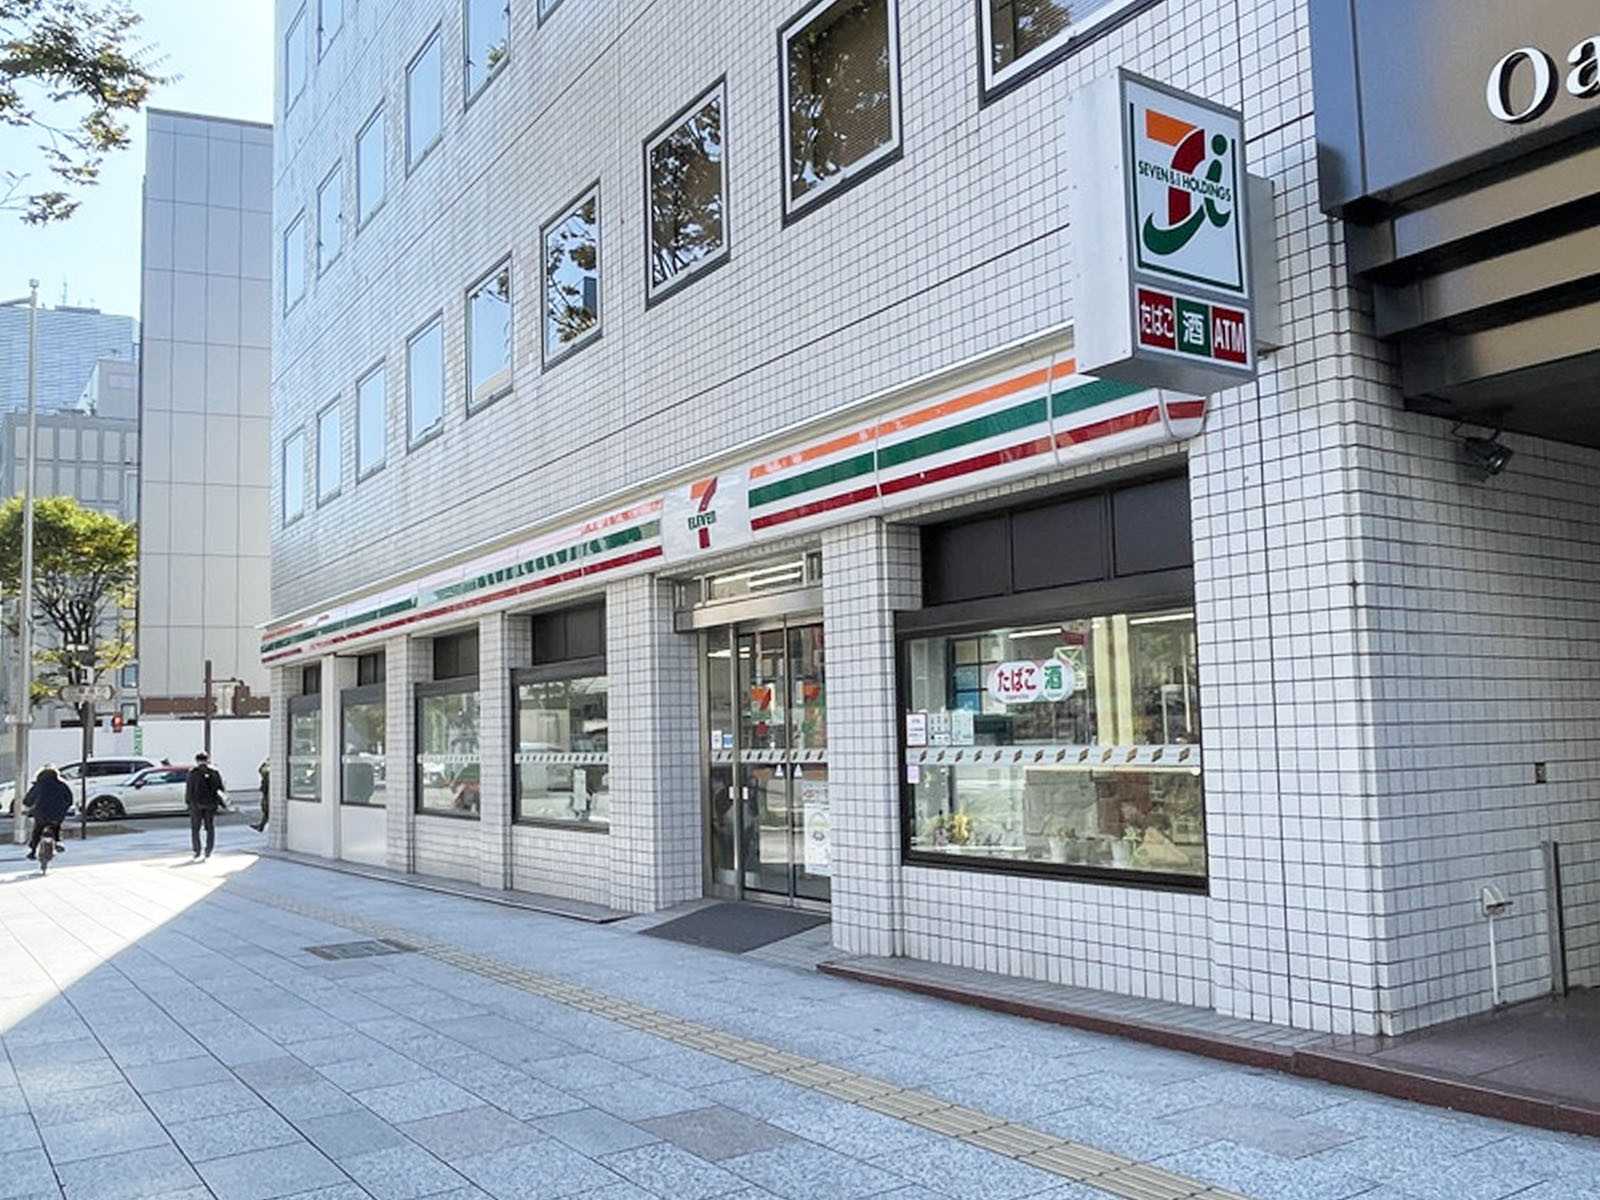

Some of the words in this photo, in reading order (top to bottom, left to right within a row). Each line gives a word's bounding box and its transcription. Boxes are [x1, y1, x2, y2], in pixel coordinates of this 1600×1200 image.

[1182, 178, 1232, 202] HOLDINGS
[1140, 302, 1174, 339] たばこ
[1182, 310, 1204, 346] 酒
[1214, 317, 1245, 354] ATM
[998, 667, 1037, 692] たばこ
[1044, 665, 1063, 690] 酒
